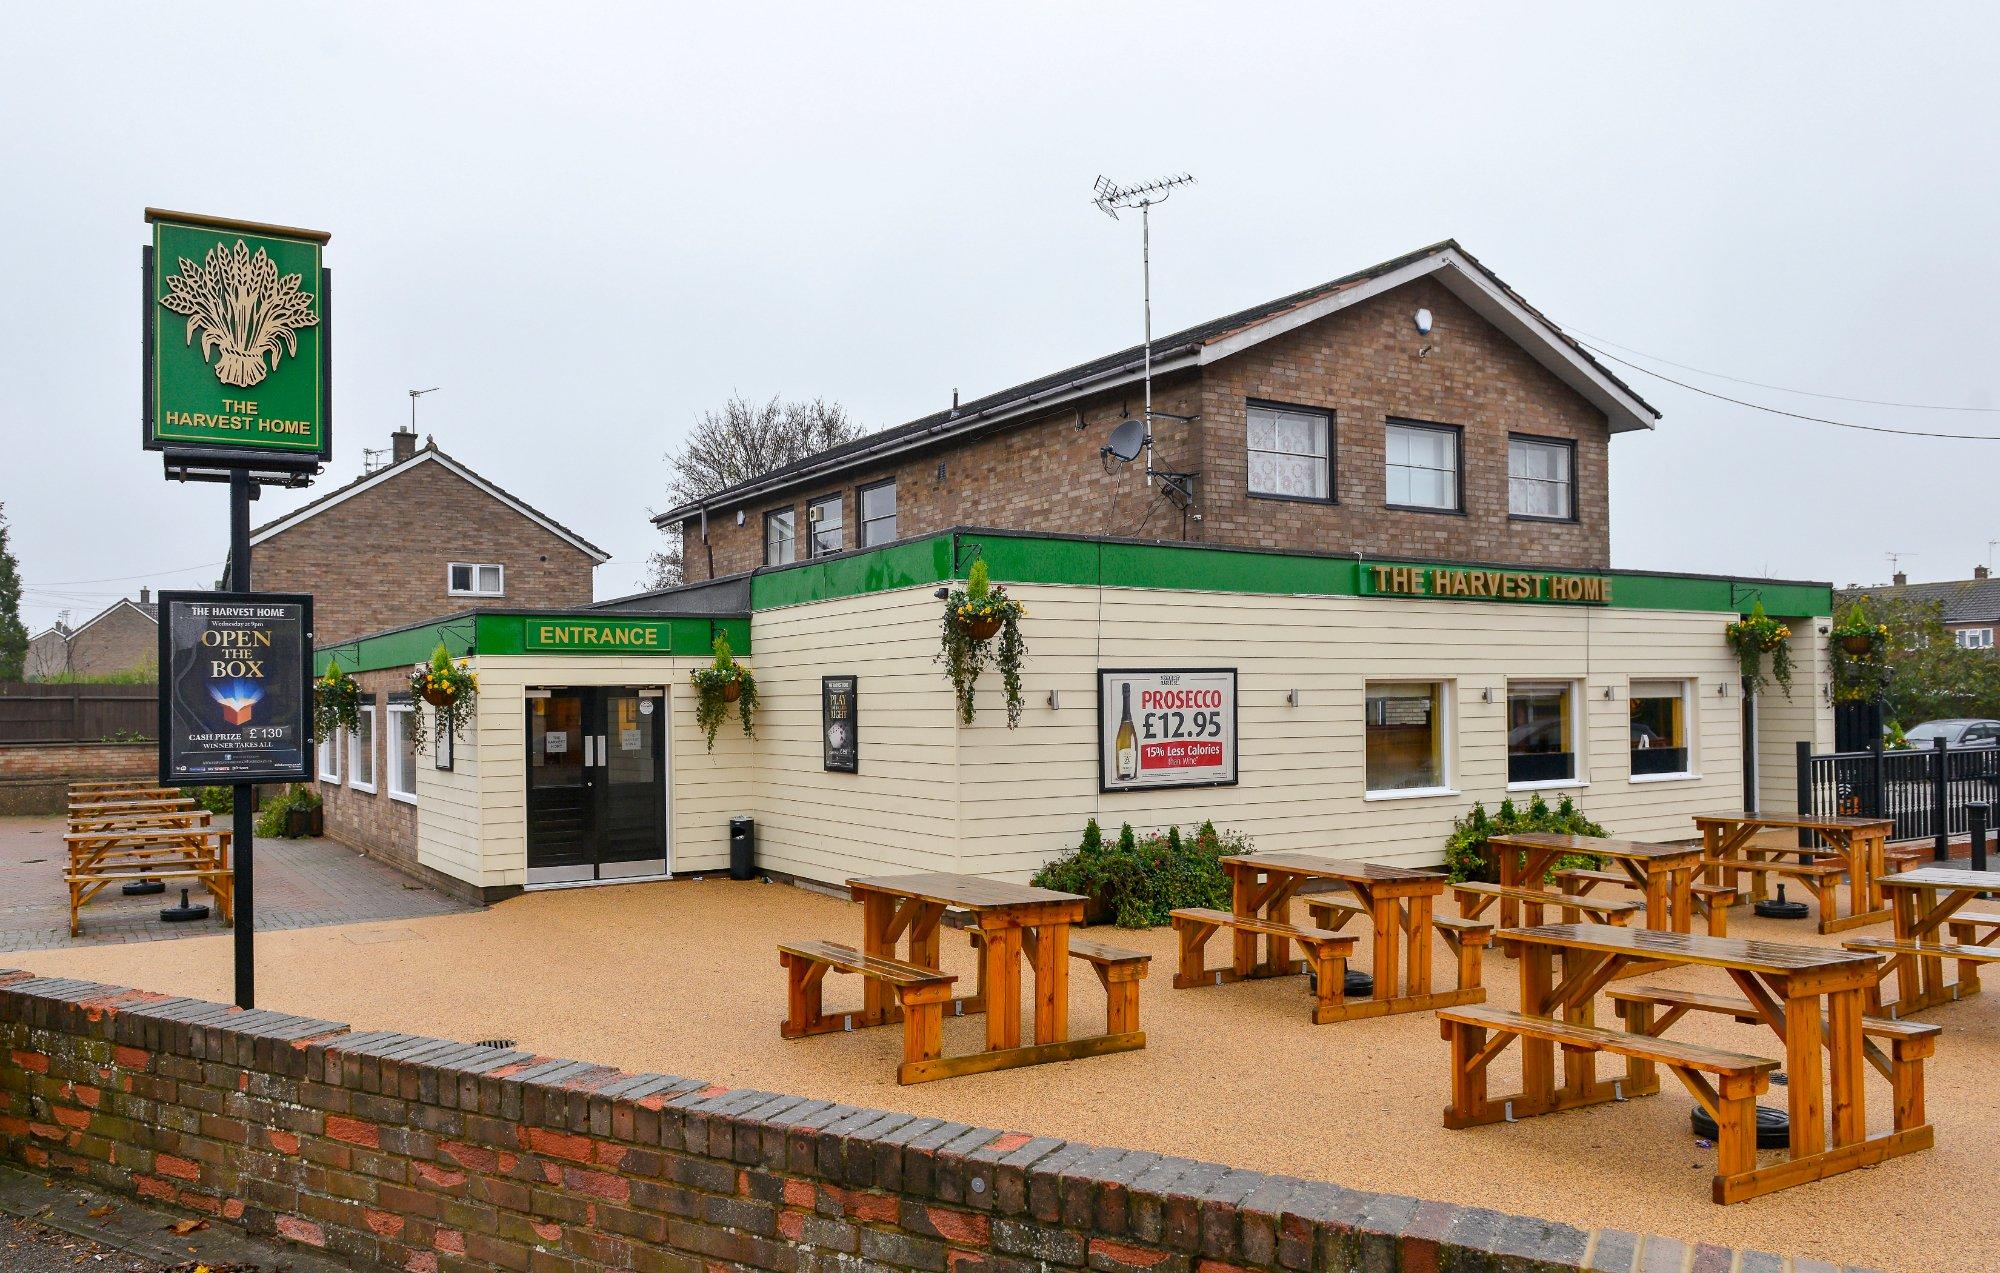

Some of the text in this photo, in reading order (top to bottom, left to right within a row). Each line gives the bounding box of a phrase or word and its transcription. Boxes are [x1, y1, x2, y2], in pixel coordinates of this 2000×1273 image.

[222, 399, 258, 415] THE
[166, 411, 311, 435] HARVEST HOME
[1373, 565, 1613, 601] THE HARVEST HOME
[192, 607, 285, 617] THE HARVEST HOME
[201, 630, 272, 647] OPEN
[540, 626, 658, 645] ENTRANCE
[222, 649, 253, 659] THE
[210, 660, 264, 678] BOX
[1141, 689, 1222, 710] PROSECCO
[1142, 711, 1222, 739] £12.95
[188, 728, 283, 741] CASH PRIZE £ 130
[1145, 743, 1220, 758] 15% Less Calories
[1168, 757, 1181, 766] than
